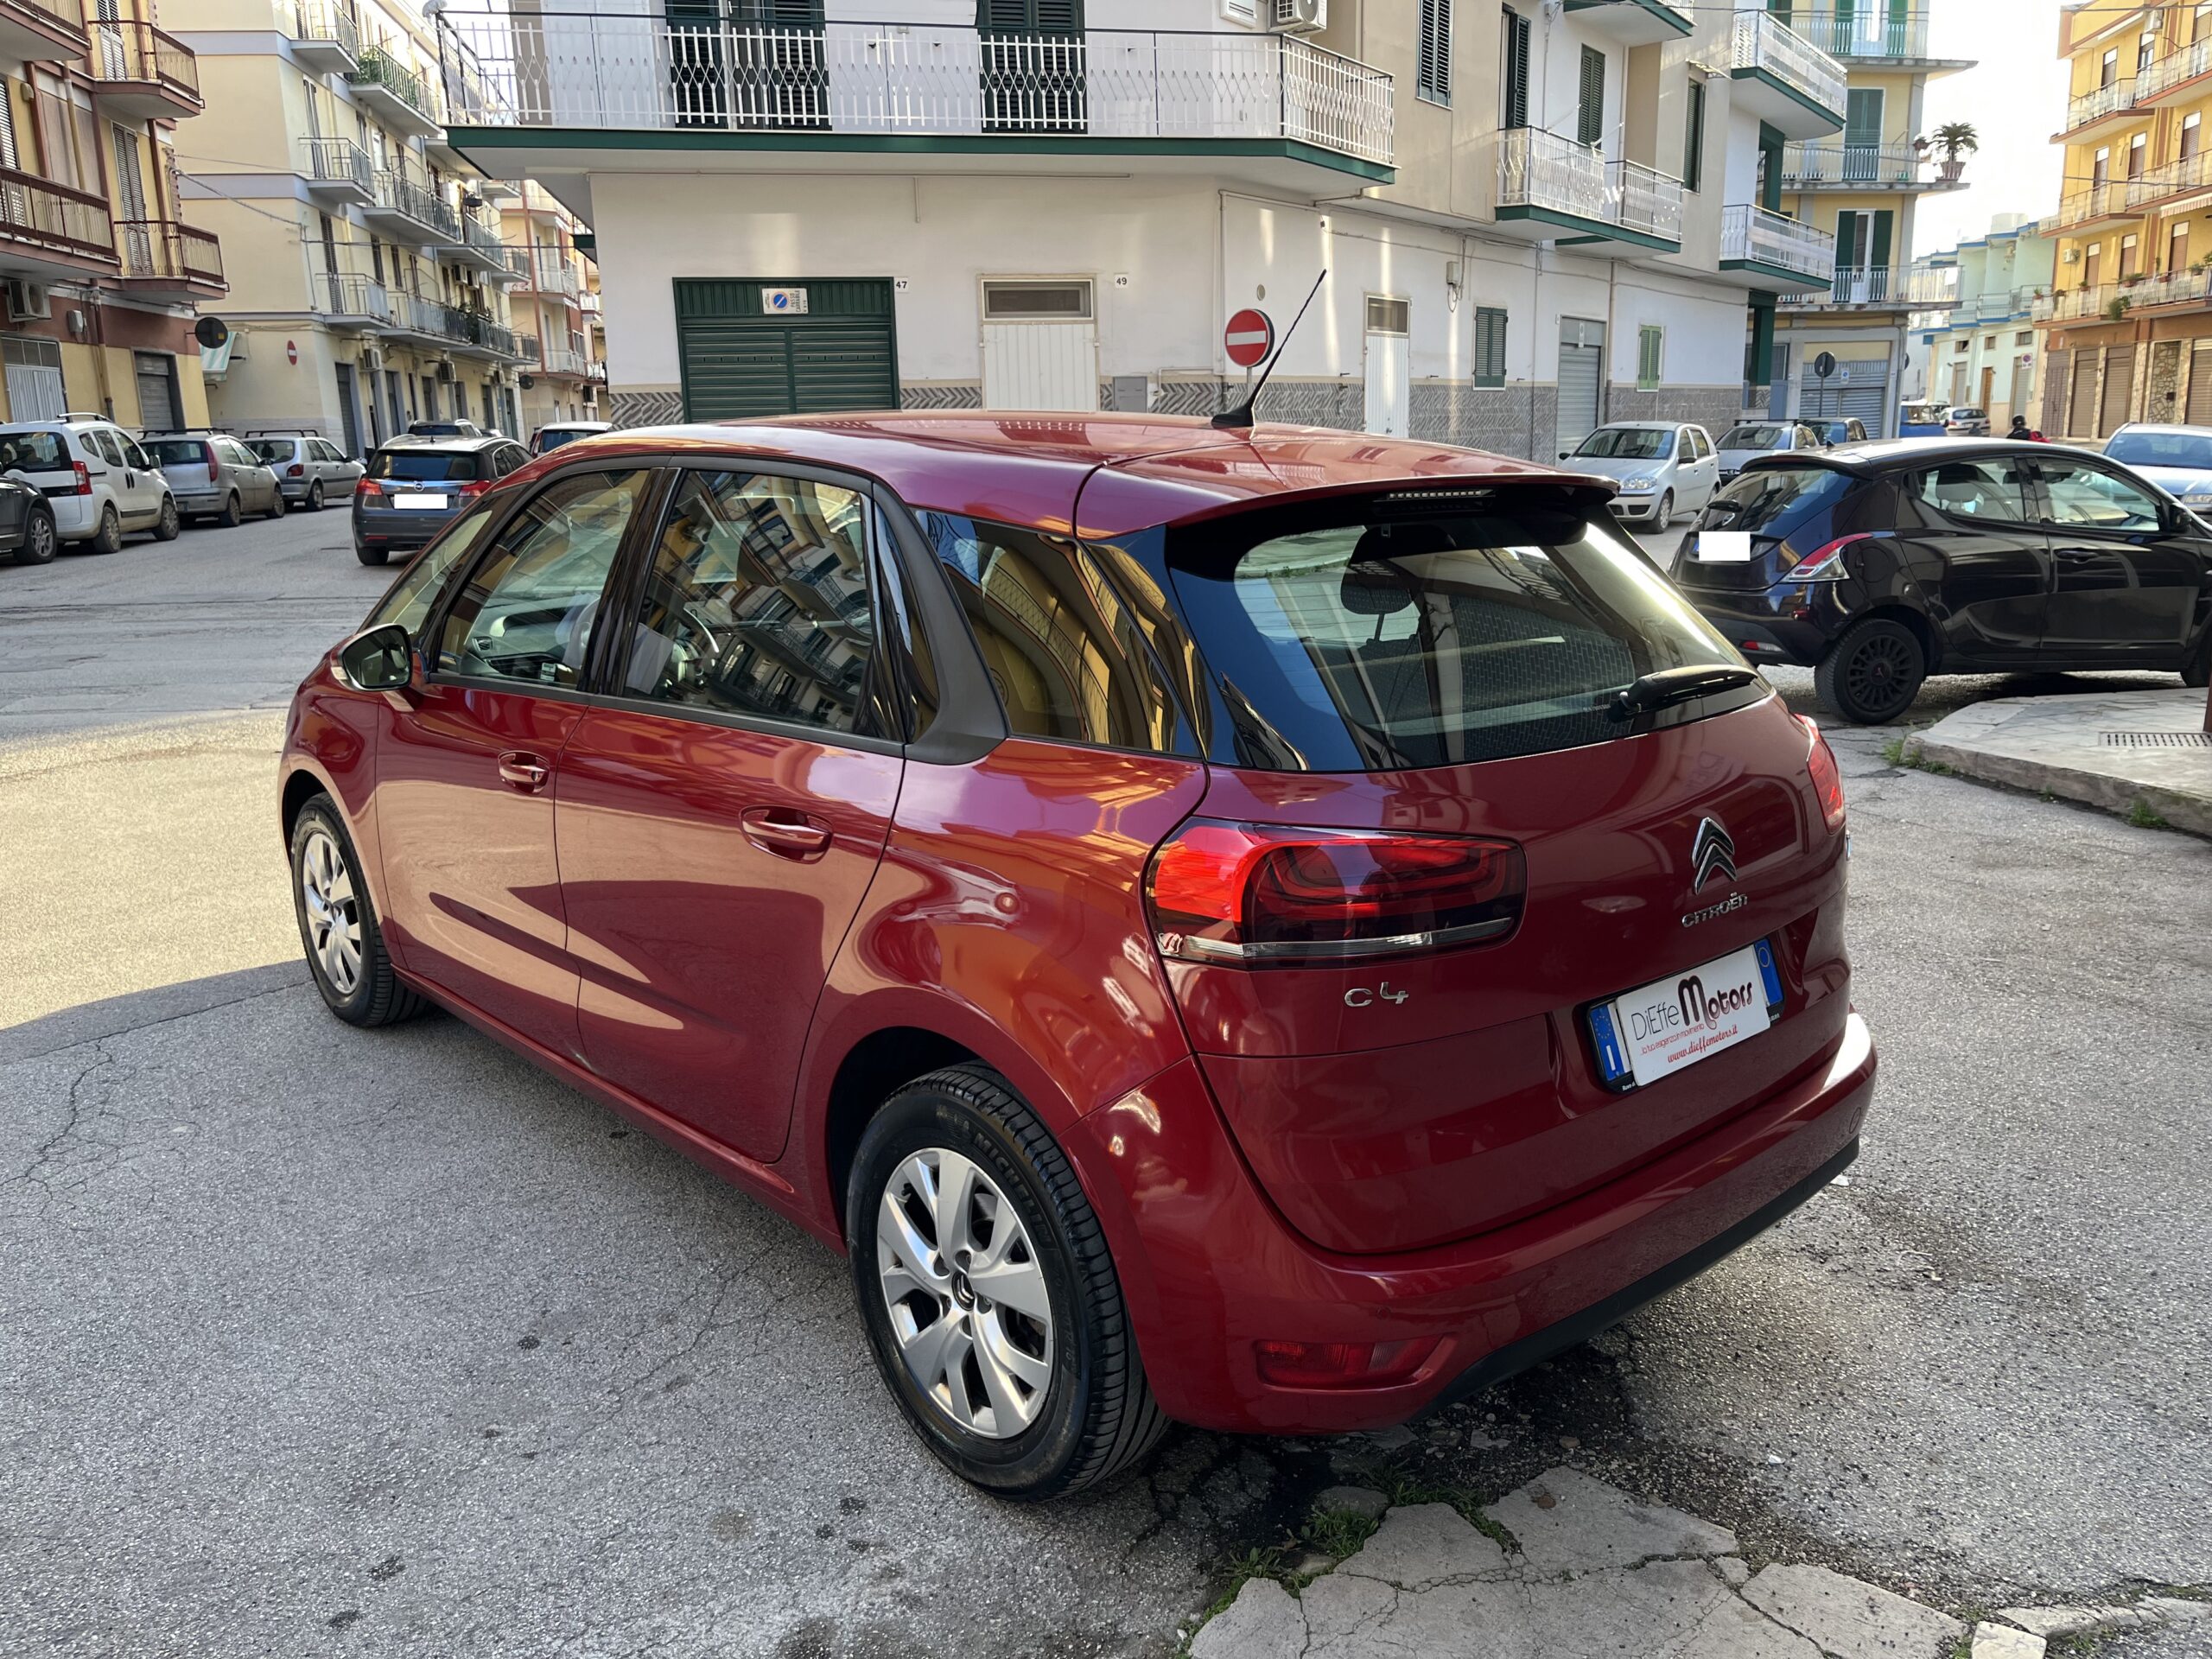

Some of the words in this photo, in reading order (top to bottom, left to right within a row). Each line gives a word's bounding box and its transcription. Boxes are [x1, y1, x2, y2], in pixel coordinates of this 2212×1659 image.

[1116, 276, 1128, 285] 49
[1630, 1001, 1680, 1041] DiEffe
[1677, 975, 1753, 1030] Motors
[1667, 1025, 1738, 1064] www.dieffemotors.it
